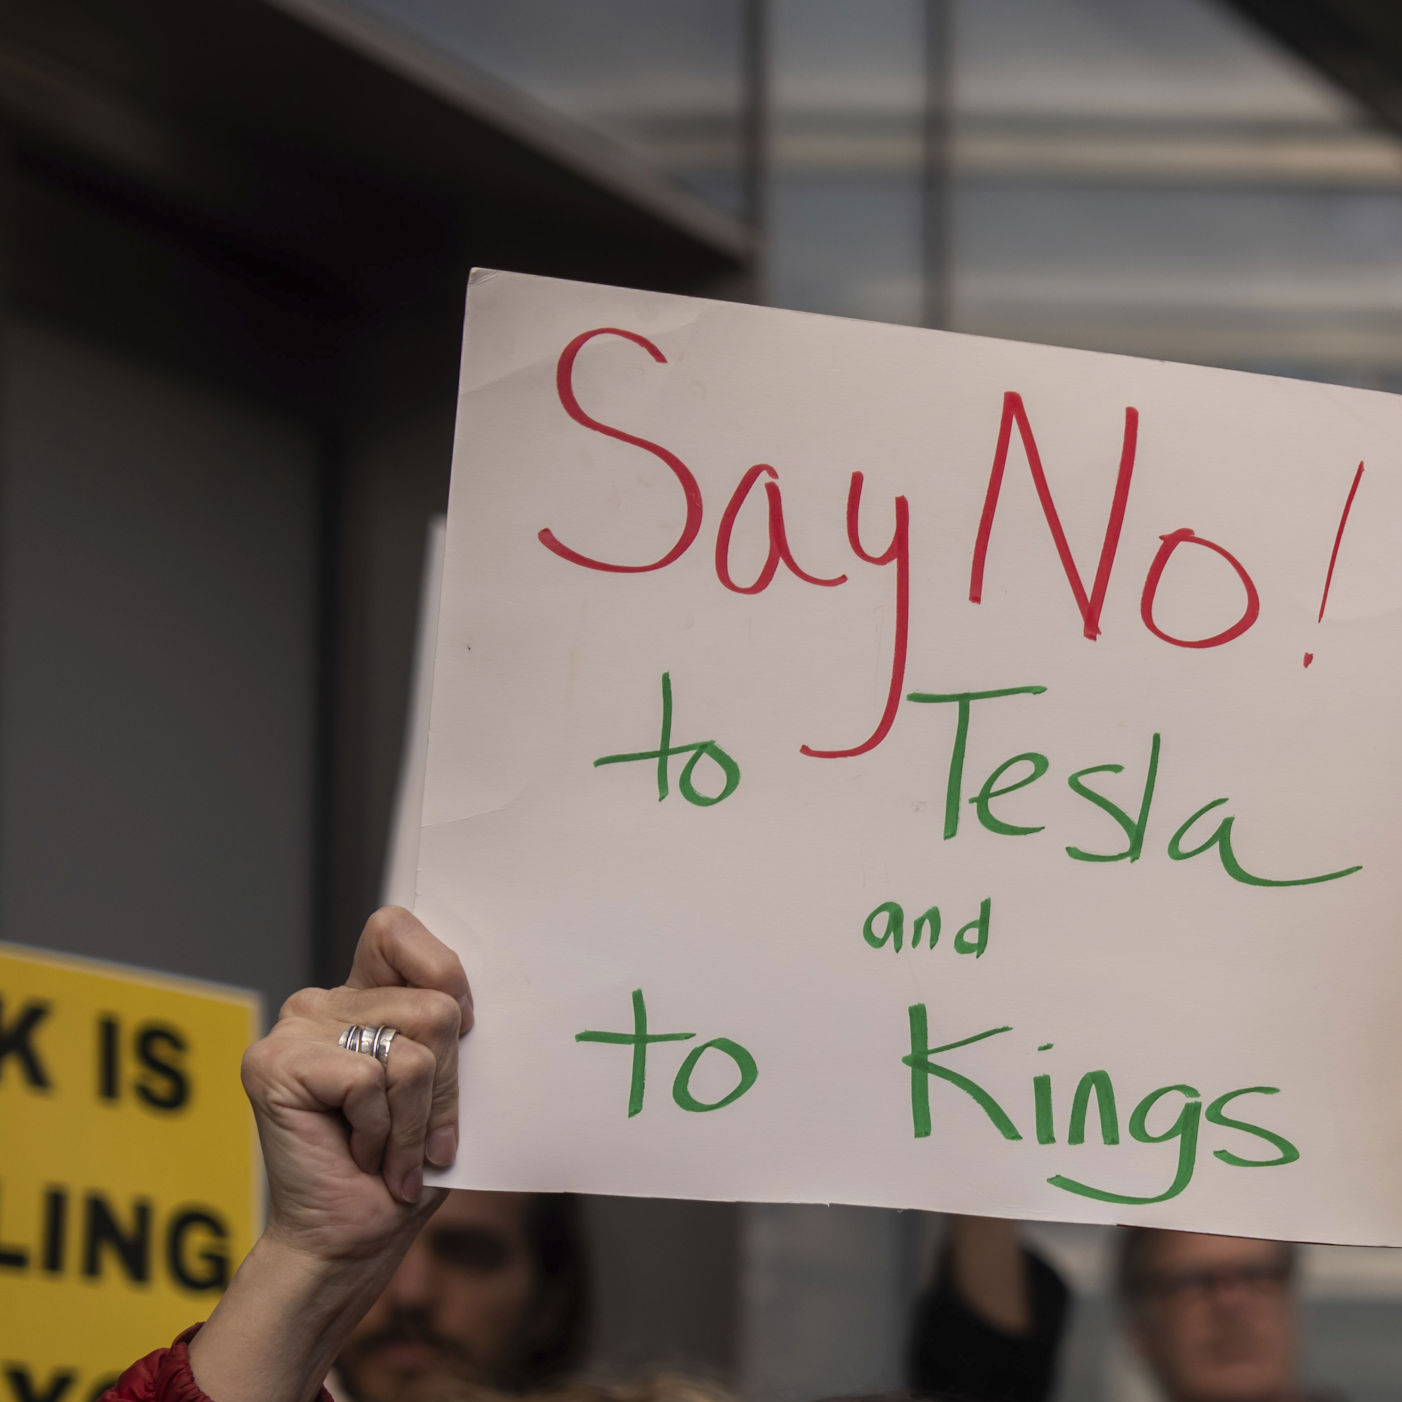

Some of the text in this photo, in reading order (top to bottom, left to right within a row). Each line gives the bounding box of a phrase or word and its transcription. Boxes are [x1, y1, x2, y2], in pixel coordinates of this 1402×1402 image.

[538, 328, 1364, 759] Say No!
[594, 674, 1360, 886] to Tesla
[864, 899, 990, 956] and
[100, 1018, 189, 1112] IS
[575, 990, 1299, 1204] to Kings
